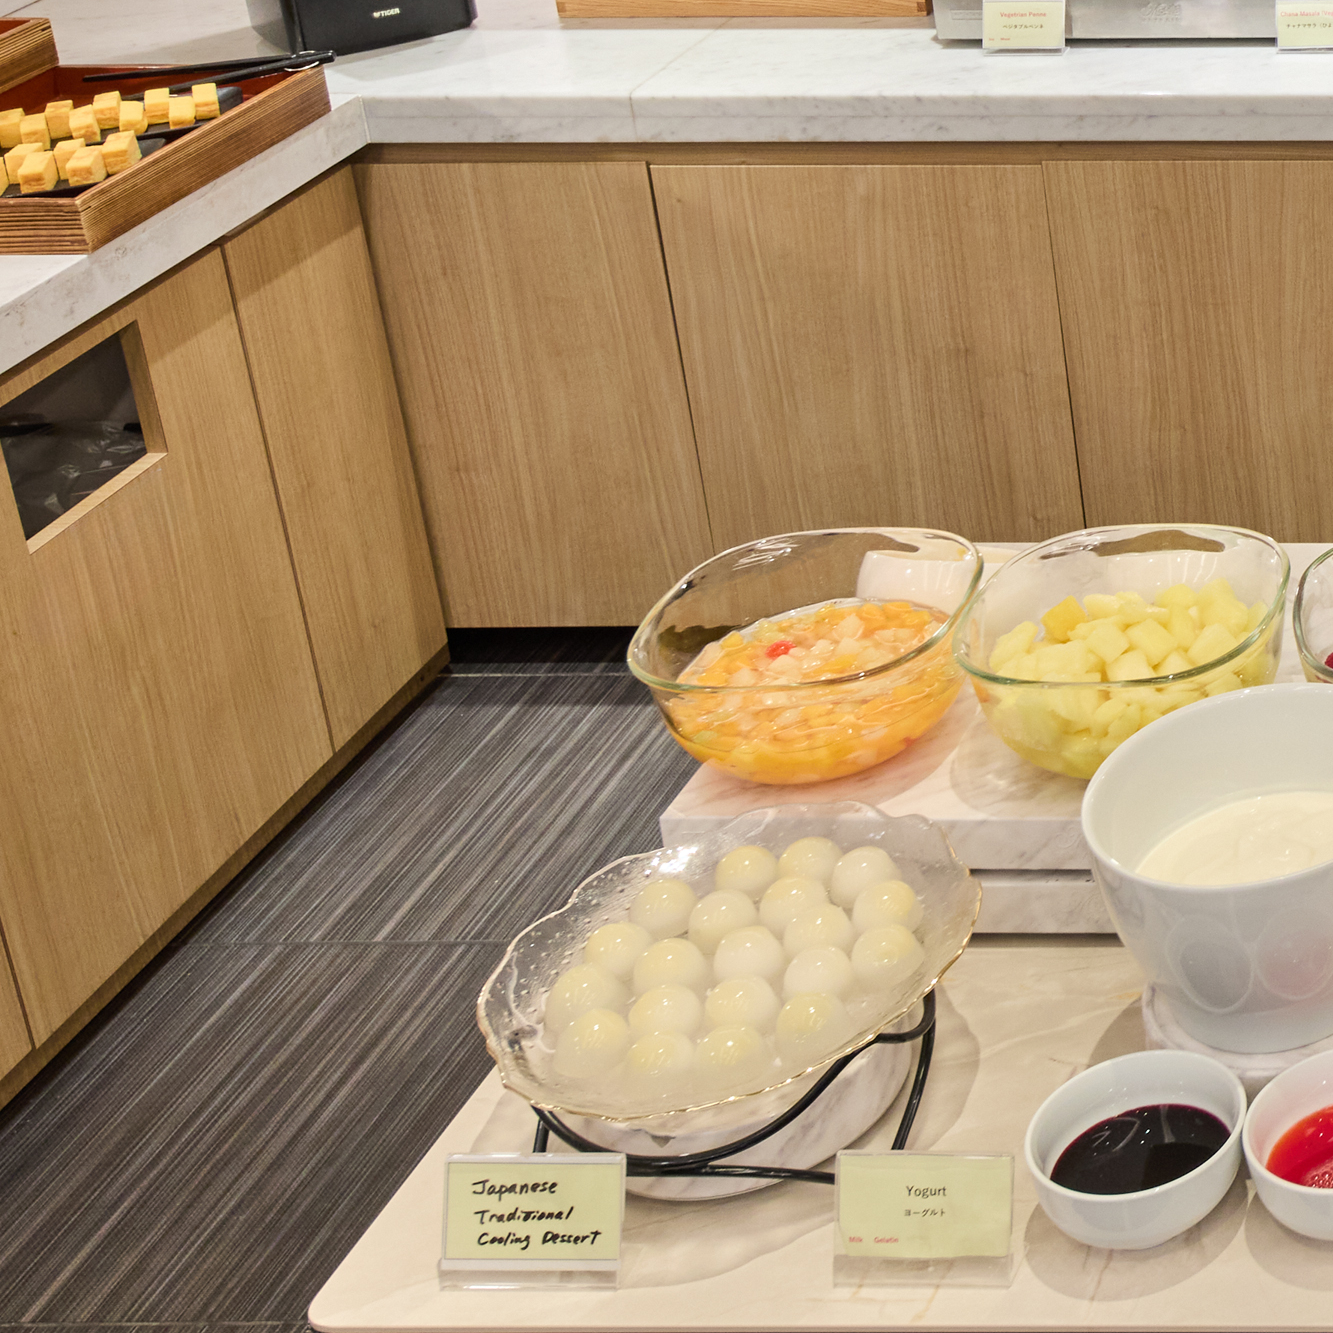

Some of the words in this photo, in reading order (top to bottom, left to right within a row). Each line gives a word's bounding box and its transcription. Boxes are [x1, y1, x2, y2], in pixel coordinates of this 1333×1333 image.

[380, 8, 400, 17] TIGER
[472, 1179, 558, 1202] Japanese
[906, 1185, 948, 1199] Yogurt
[474, 1205, 574, 1225] Traditional
[904, 1208, 946, 1217] ヨーグルト
[477, 1231, 531, 1251] Cooling
[542, 1230, 602, 1246] Dessert
